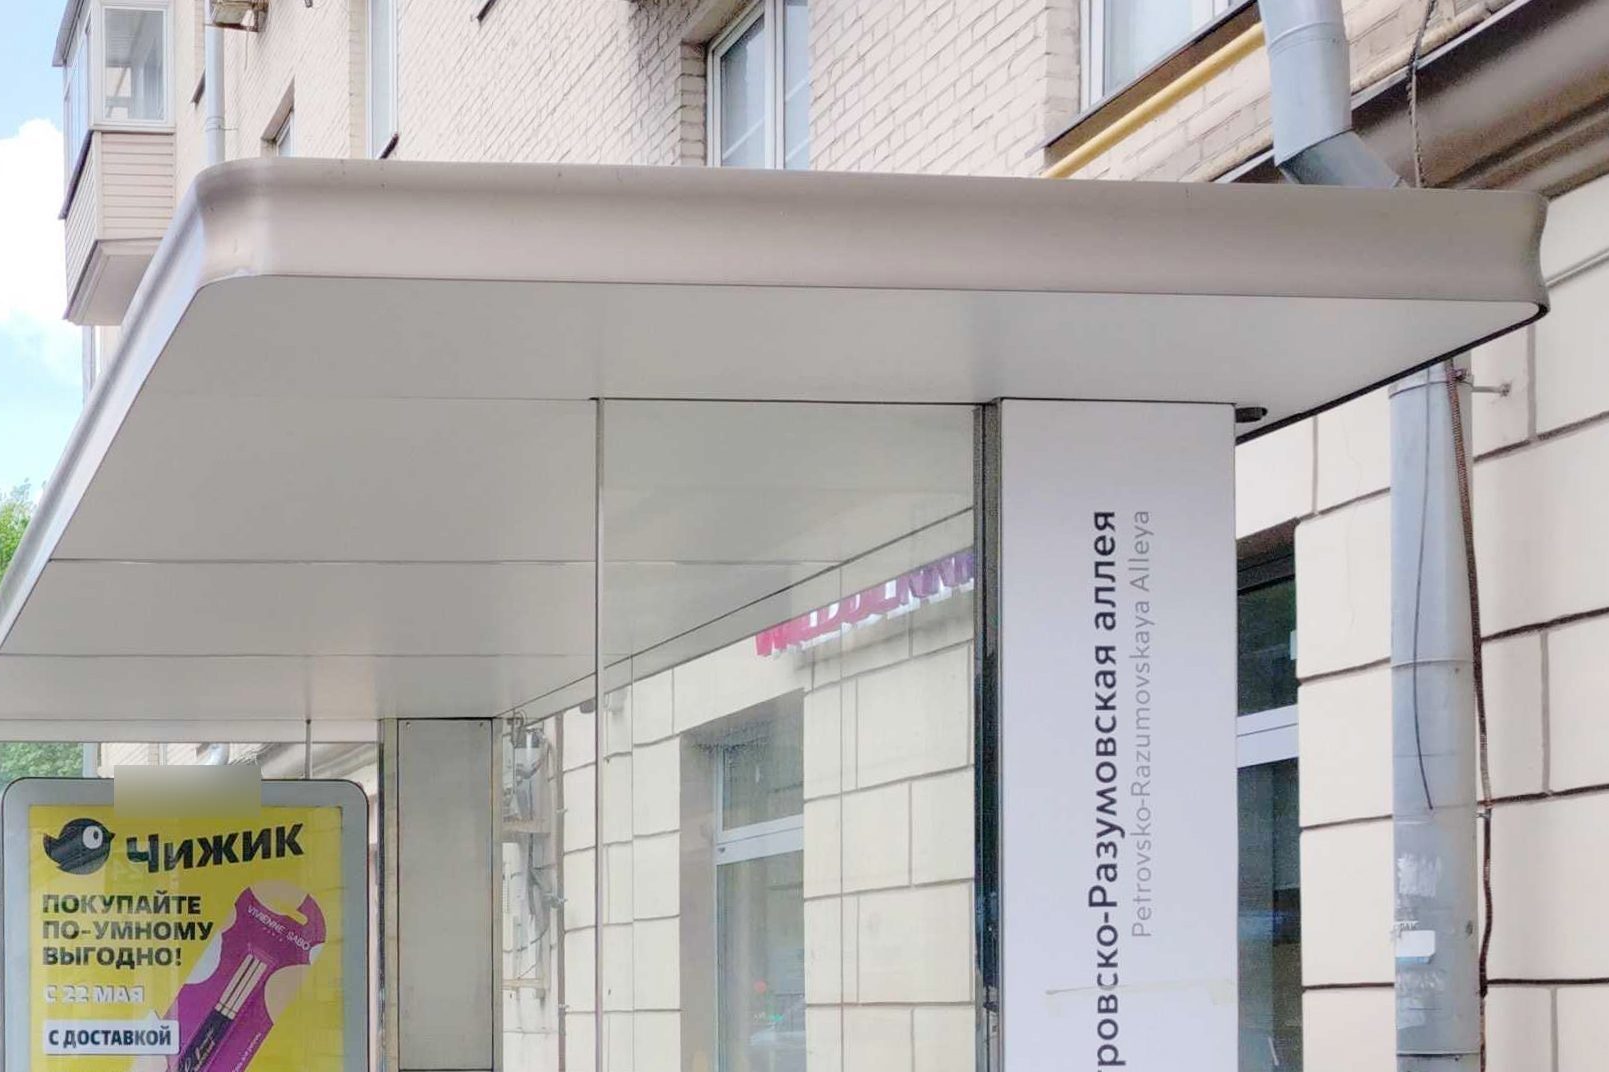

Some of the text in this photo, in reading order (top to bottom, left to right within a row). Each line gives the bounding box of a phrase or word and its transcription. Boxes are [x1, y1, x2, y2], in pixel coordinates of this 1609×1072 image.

[1093, 511, 1117, 631] аллея
[1128, 510, 1155, 937] Petrovsko-Razumovskaya Alleya
[42, 890, 202, 915] ПОКУПАЙТЕ
[42, 921, 214, 942] ПО-УМНОМУ
[42, 946, 182, 970] ВЫГОДНО!
[44, 985, 145, 1003] С 22 МАЯ
[48, 1025, 172, 1048] С ДОСТАВКОЙ
